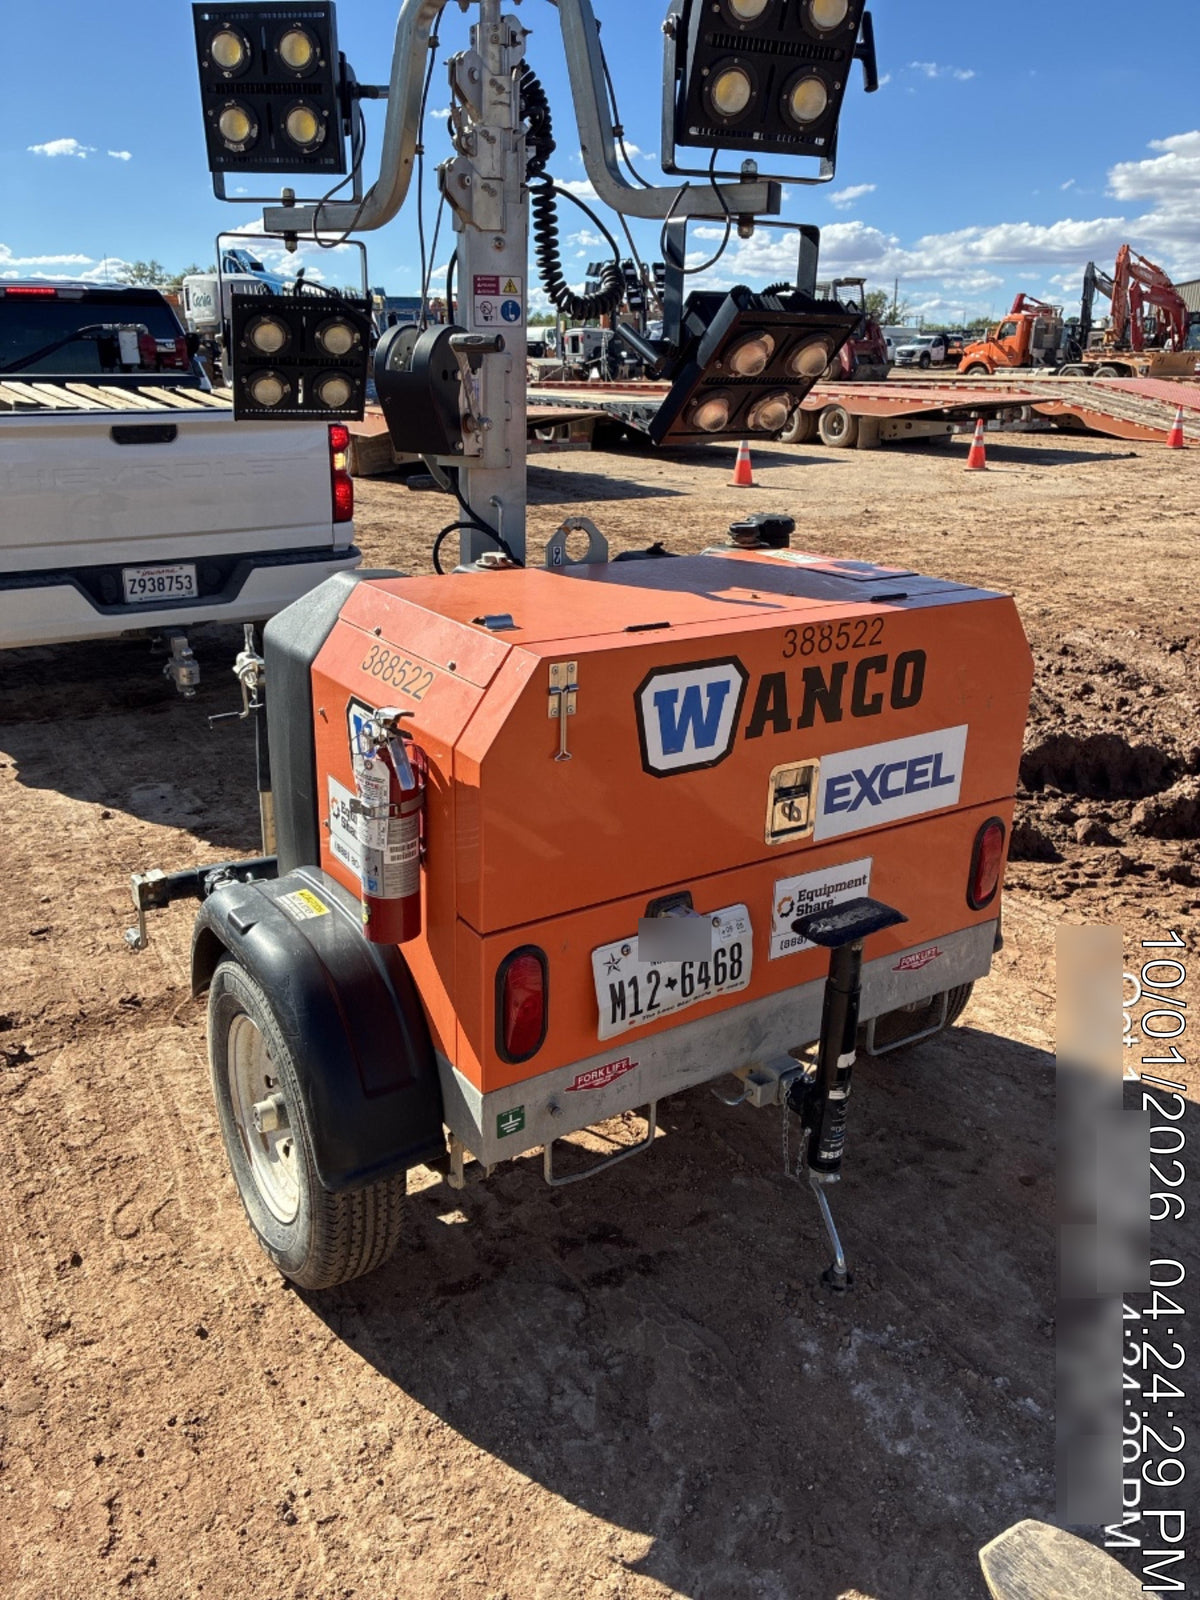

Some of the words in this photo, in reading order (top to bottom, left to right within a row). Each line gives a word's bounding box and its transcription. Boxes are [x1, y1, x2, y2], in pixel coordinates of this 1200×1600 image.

[128, 575, 193, 595] Z938753
[782, 617, 885, 659] 388522
[361, 645, 434, 700] 388522
[652, 649, 927, 756] WANCO
[823, 752, 956, 816] EXCEL
[796, 899, 834, 917] Share
[797, 874, 867, 903] Equipment
[608, 969, 661, 1025] M12
[681, 942, 742, 998] 6468
